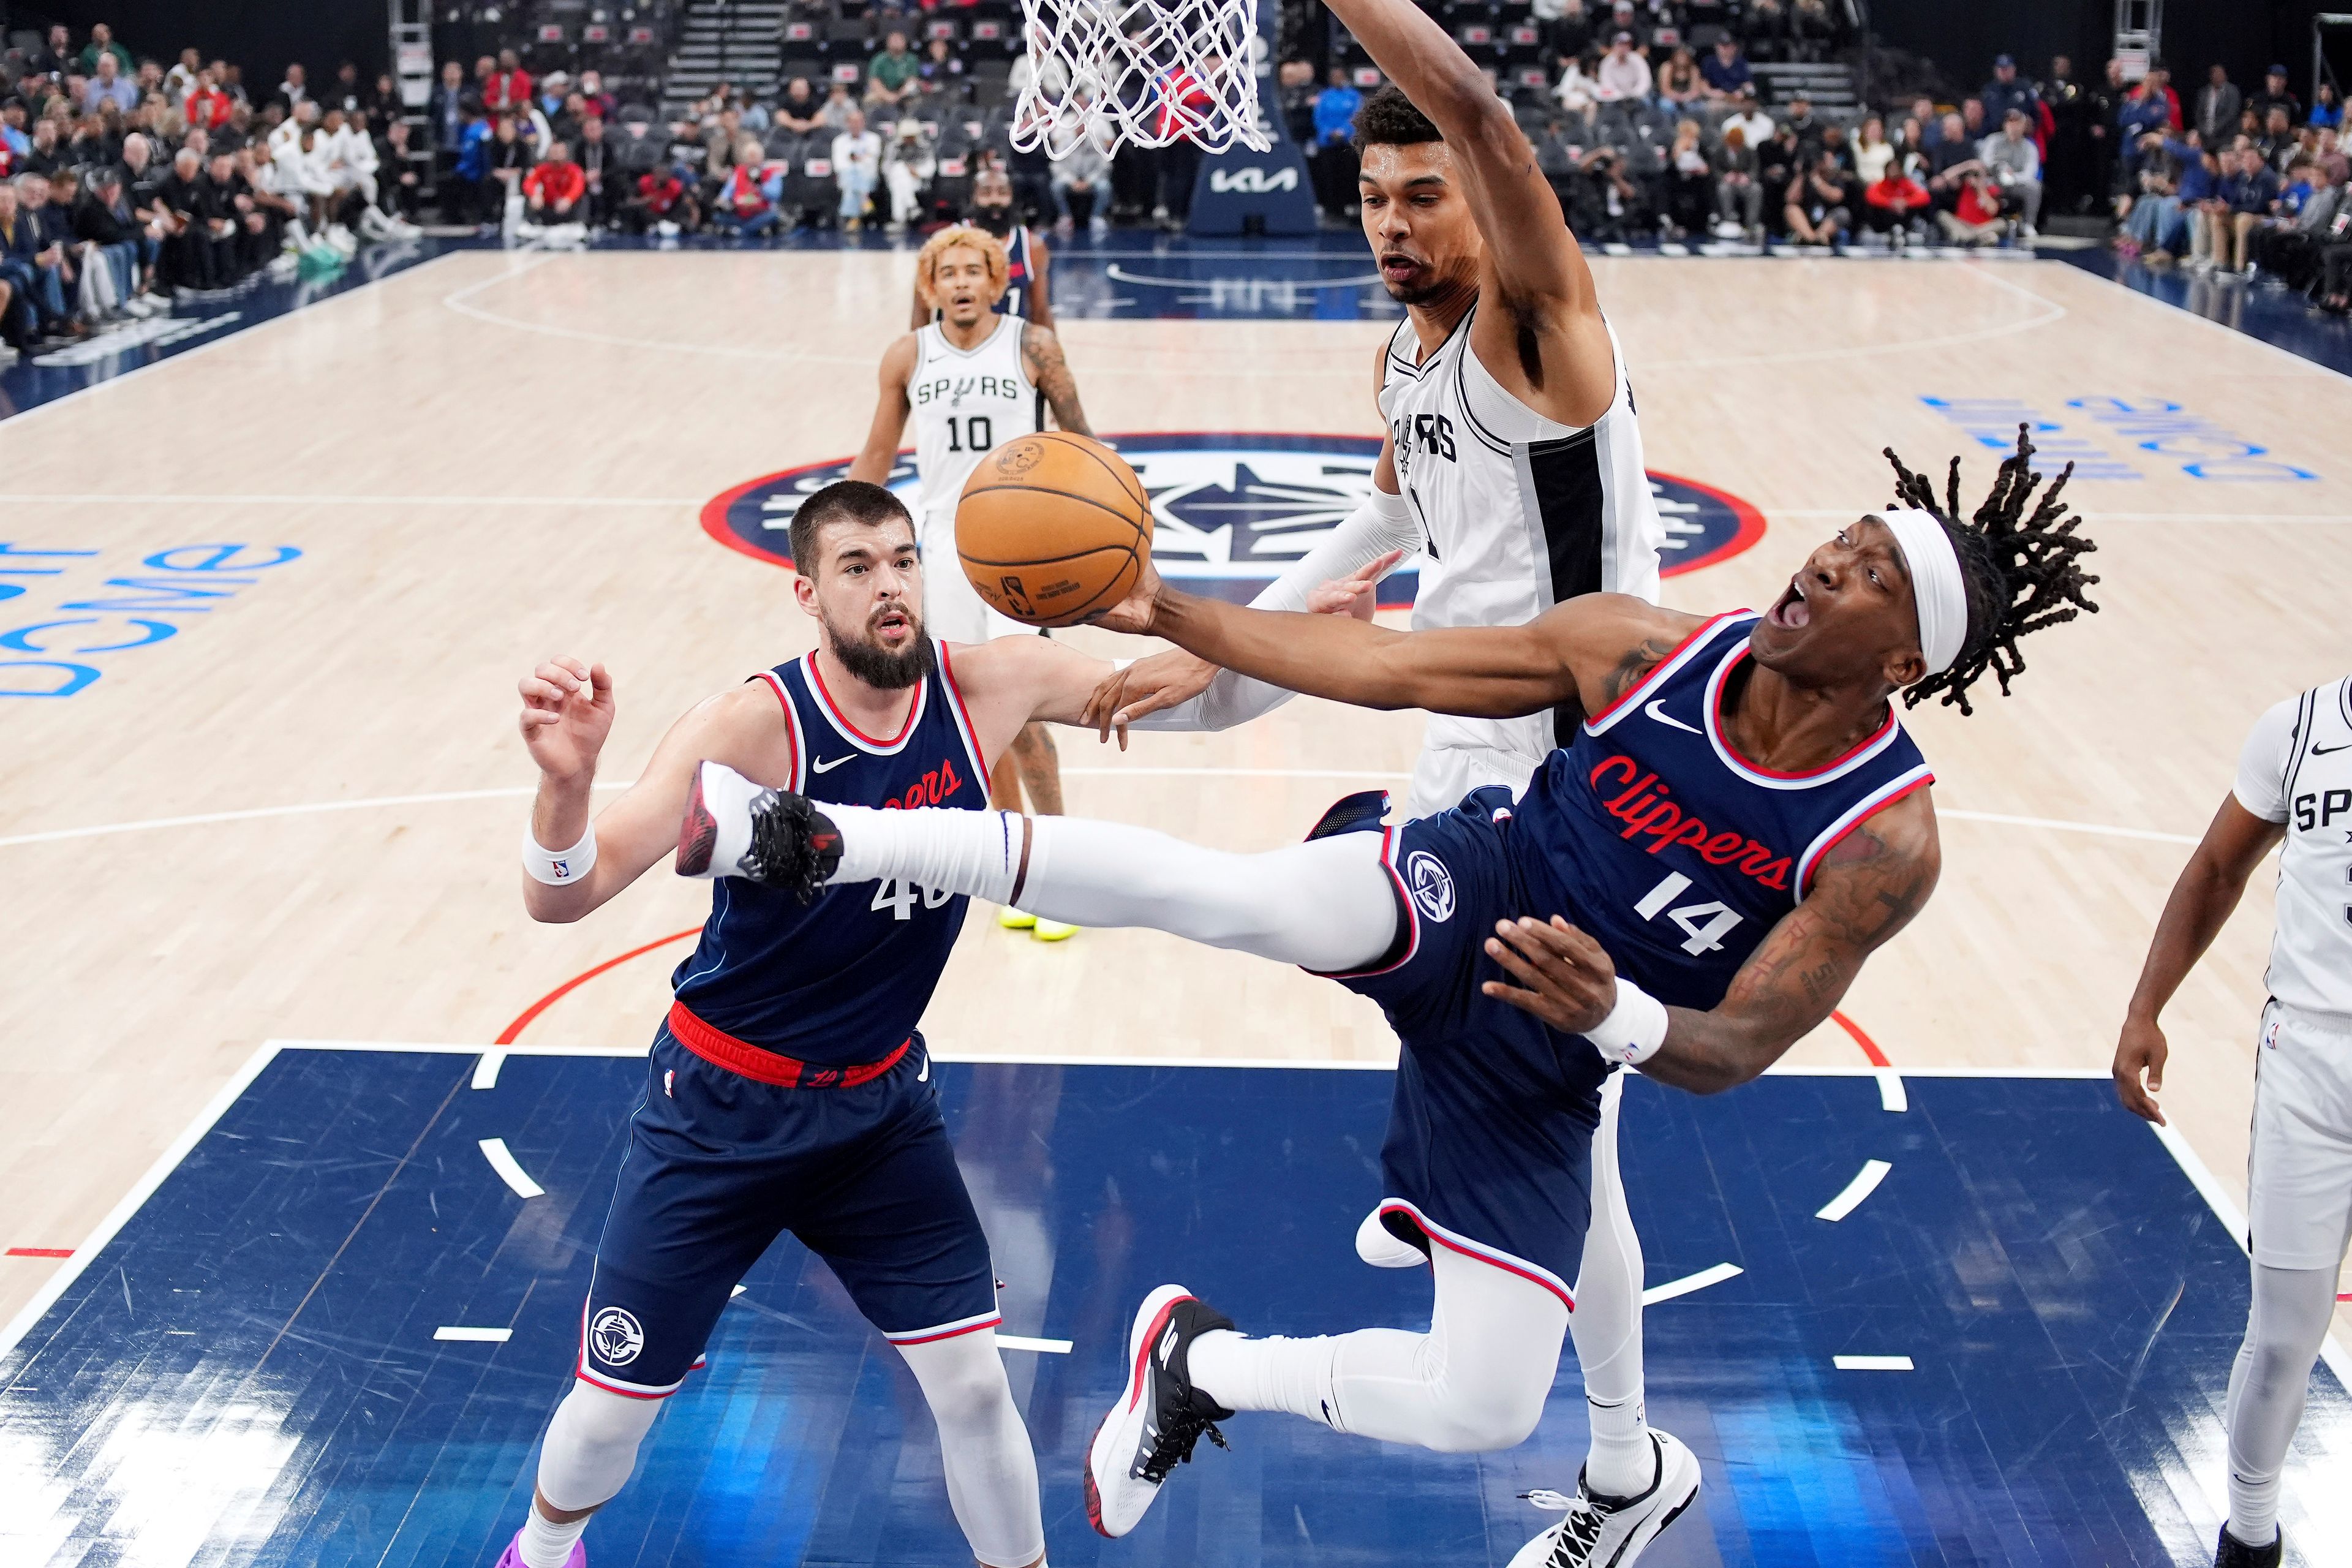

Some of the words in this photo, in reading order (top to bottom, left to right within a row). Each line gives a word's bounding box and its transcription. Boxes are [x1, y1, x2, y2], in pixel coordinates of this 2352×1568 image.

[1210, 167, 1298, 193] KIA
[918, 377, 1017, 406] SPURS
[948, 417, 992, 451] 10
[1590, 755, 1793, 891] Clippers
[1634, 870, 1744, 956] 14
